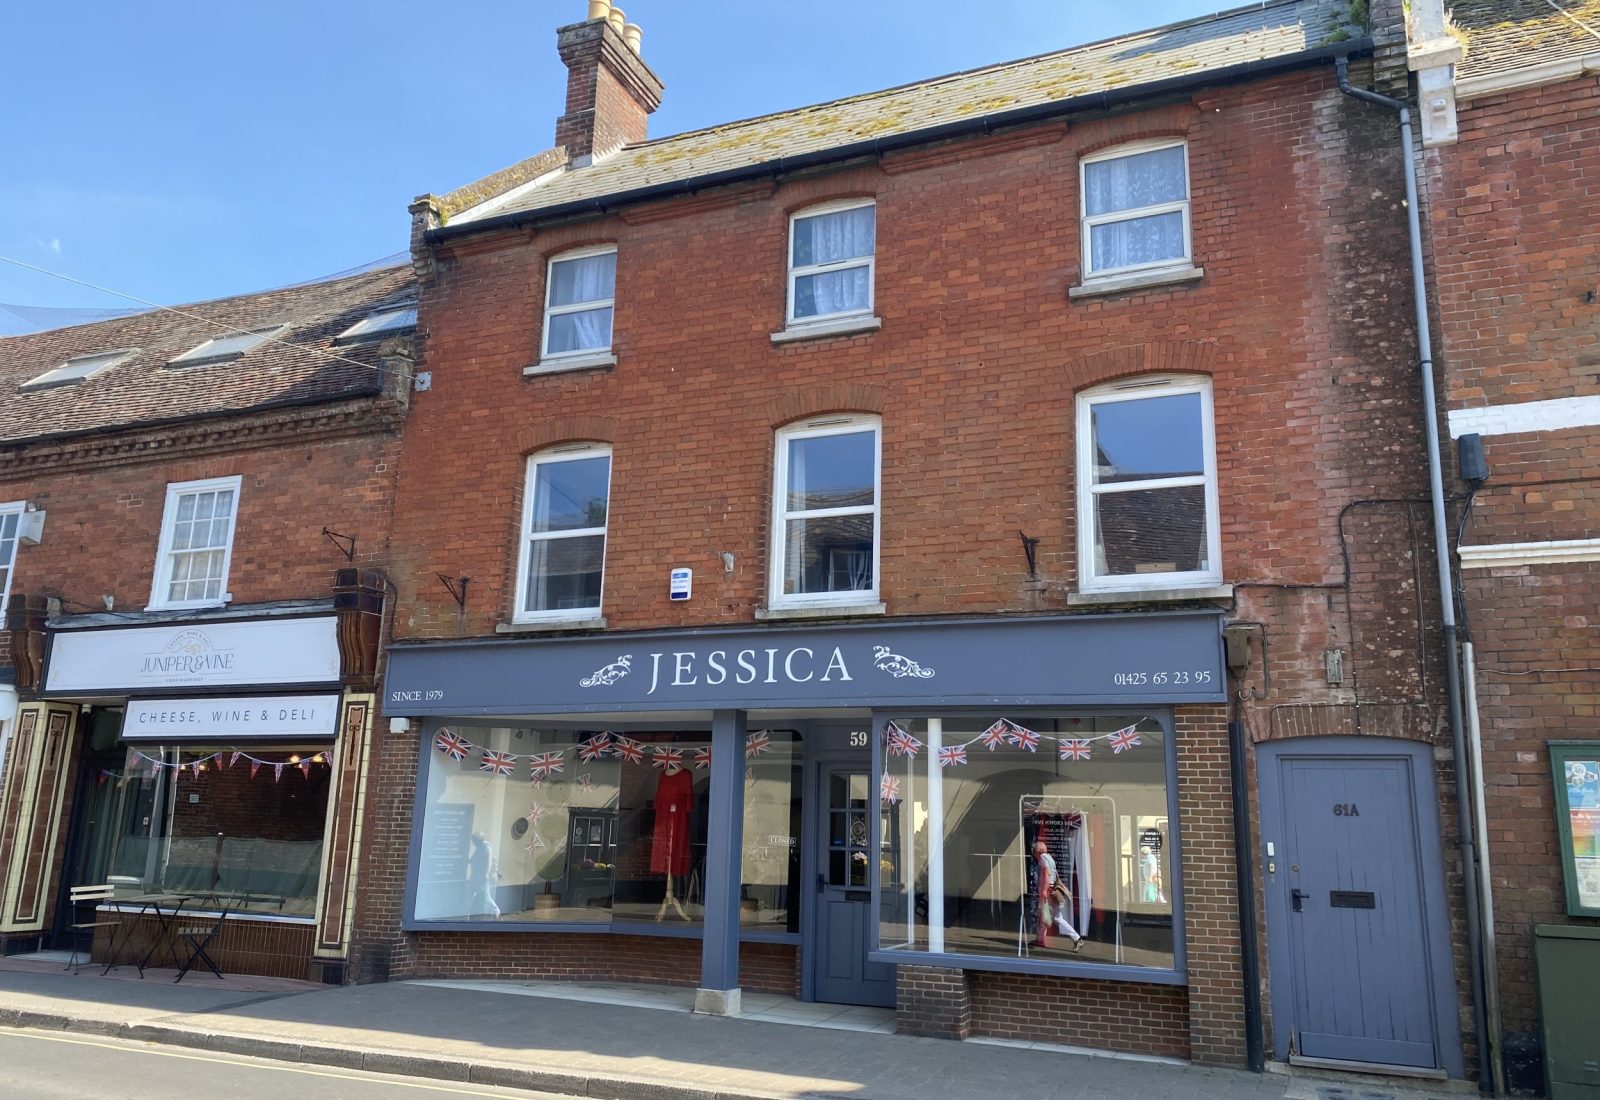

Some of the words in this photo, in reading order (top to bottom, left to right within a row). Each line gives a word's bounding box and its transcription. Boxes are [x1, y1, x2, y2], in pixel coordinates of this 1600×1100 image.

[647, 646, 853, 695] JESSICA
[1114, 672, 1147, 685] 01425
[1153, 672, 1168, 684] 65
[1174, 671, 1189, 684] 23
[1195, 671, 1211, 684] 95
[392, 691, 421, 701] SINCE
[425, 690, 443, 700] 1979
[139, 712, 200, 724] CHEESE,
[212, 710, 251, 721] WINE
[261, 710, 268, 721] &
[279, 709, 315, 720] DELI
[850, 731, 868, 746] 59
[1333, 803, 1360, 816] 61A
